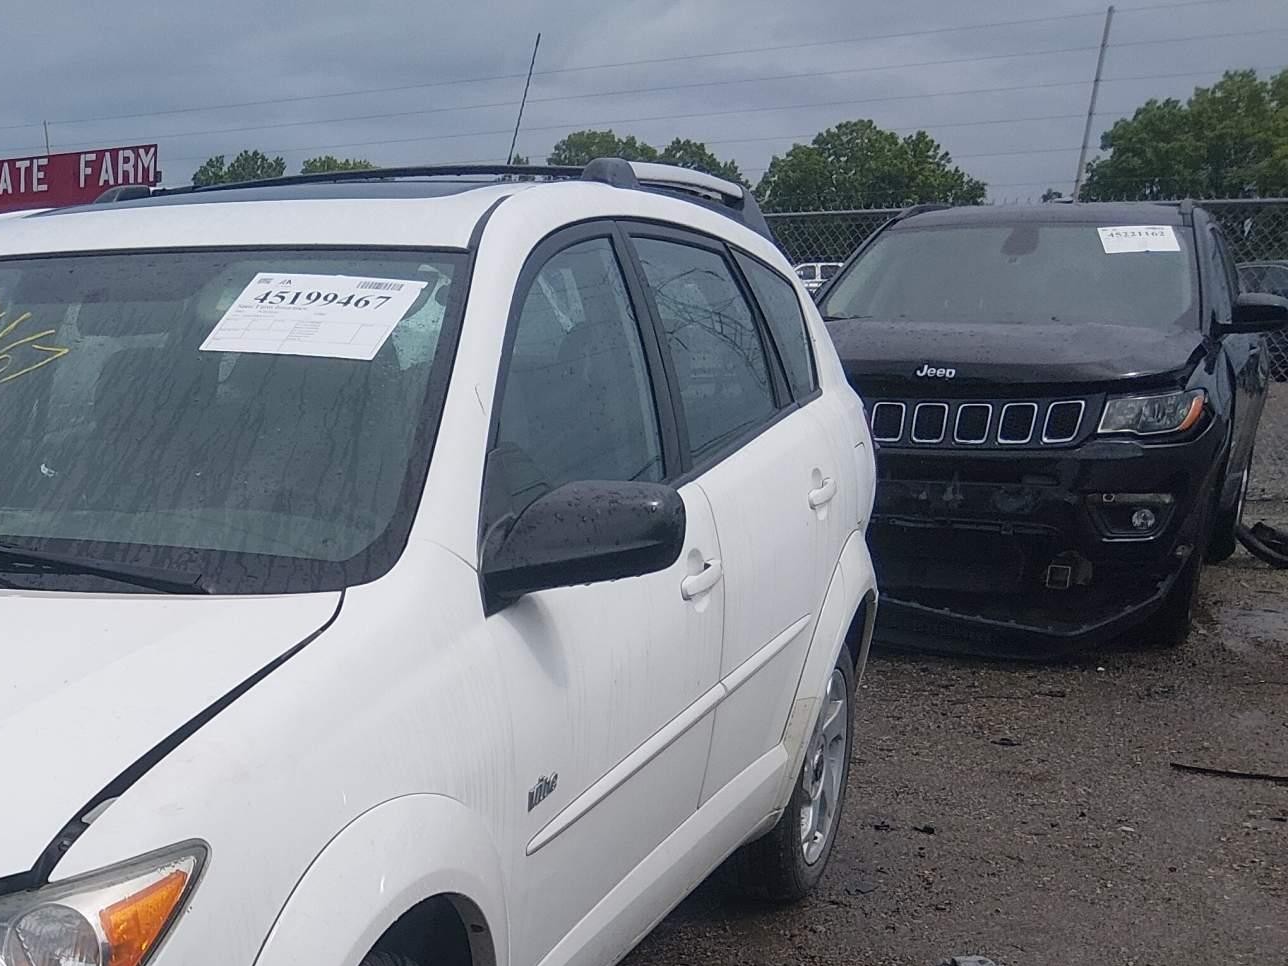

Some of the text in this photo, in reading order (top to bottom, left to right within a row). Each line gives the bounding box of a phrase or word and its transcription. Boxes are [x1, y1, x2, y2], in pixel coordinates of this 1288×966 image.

[79, 147, 155, 188] FARM
[254, 290, 392, 310] 45199467
[916, 364, 956, 380] Jeep
